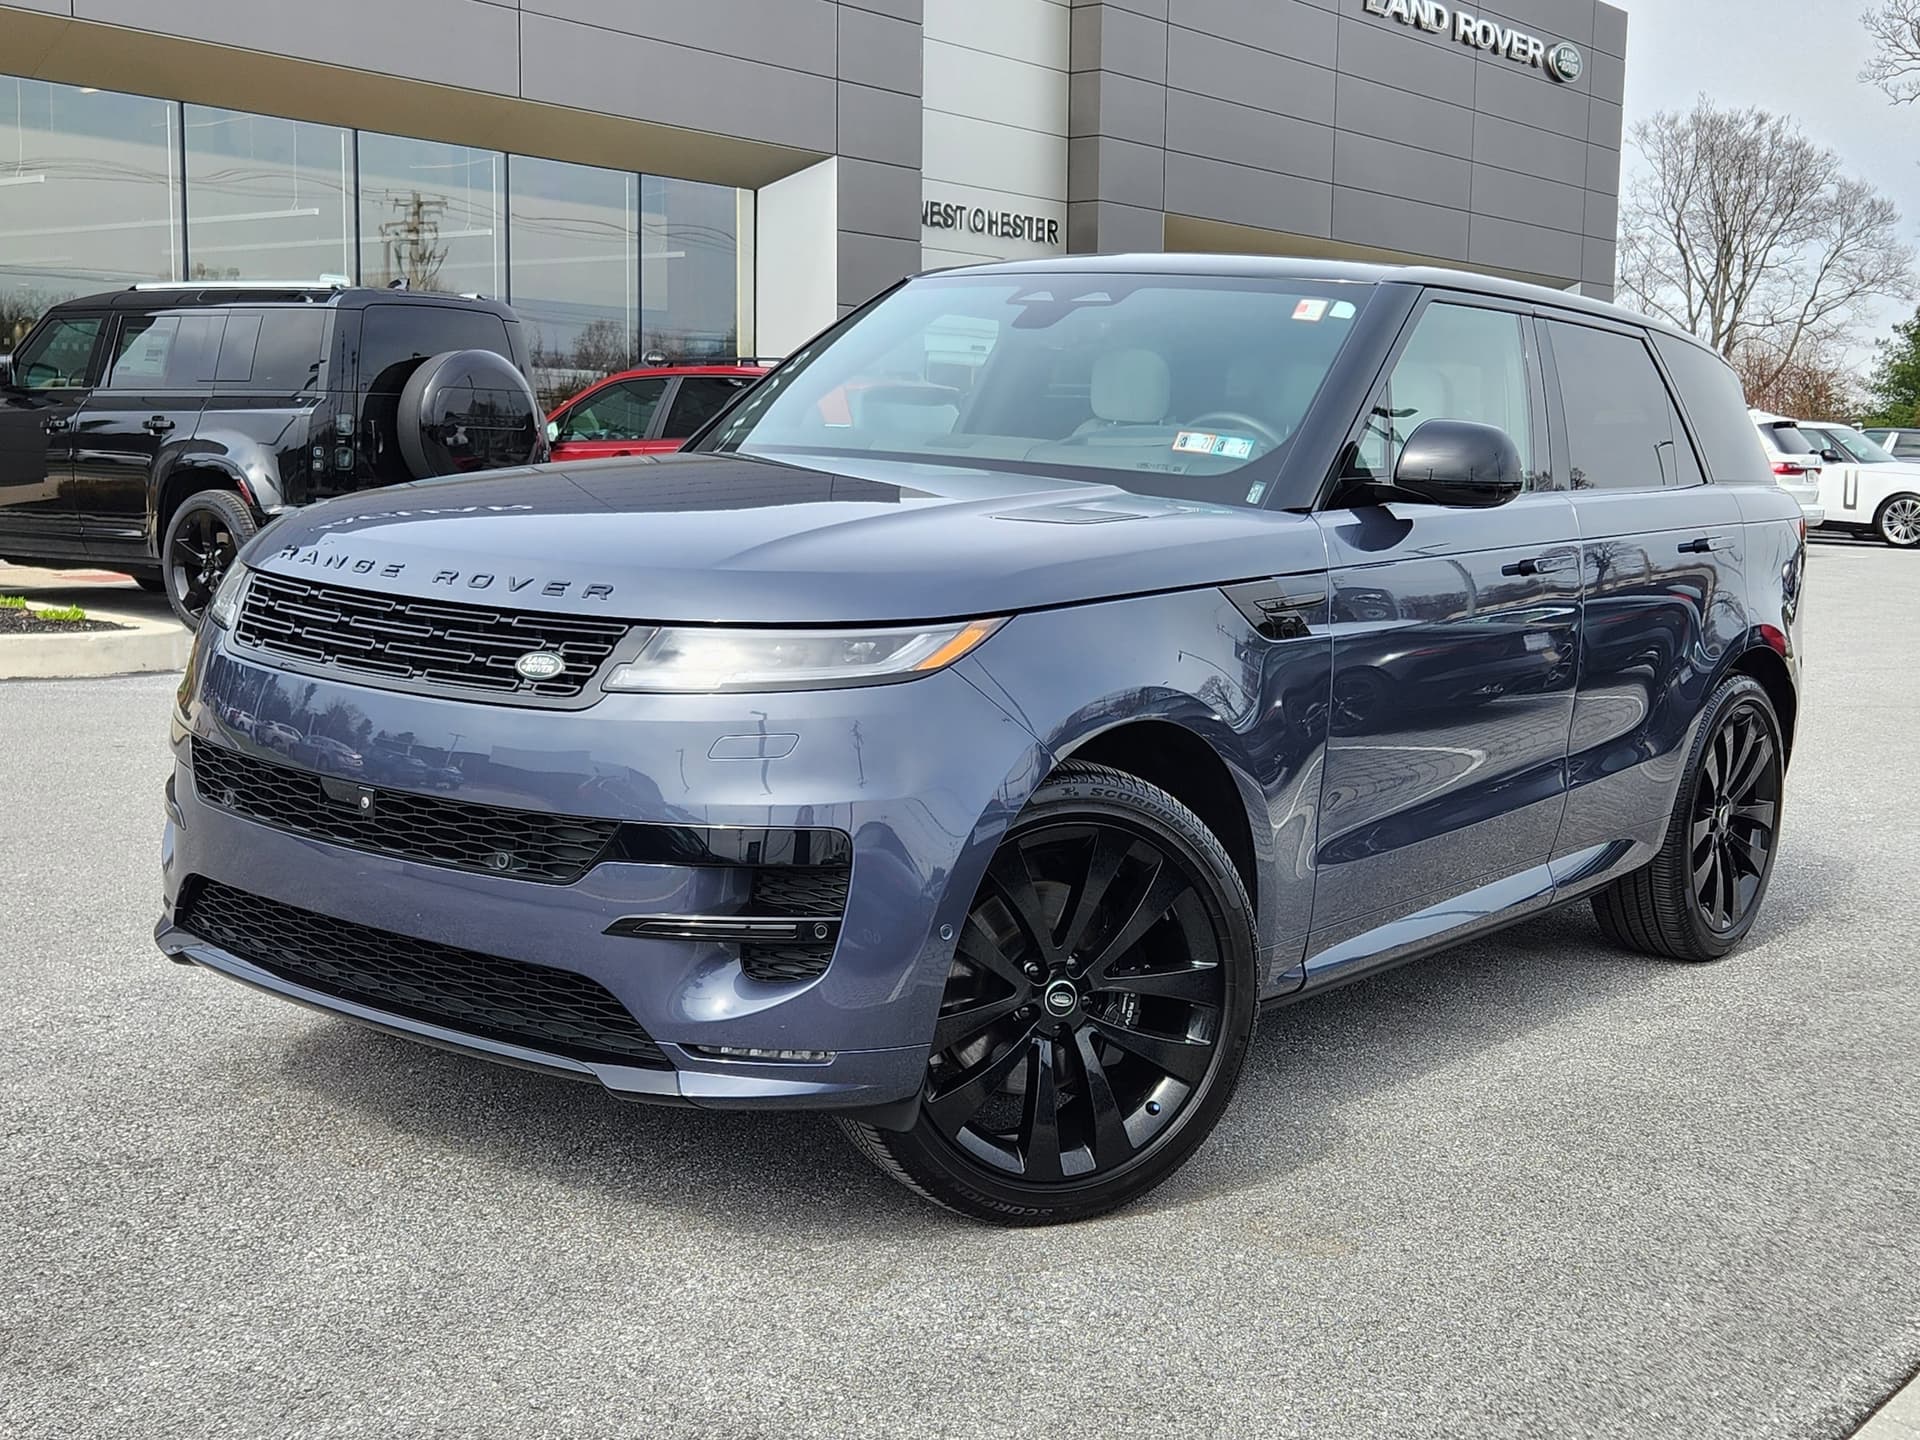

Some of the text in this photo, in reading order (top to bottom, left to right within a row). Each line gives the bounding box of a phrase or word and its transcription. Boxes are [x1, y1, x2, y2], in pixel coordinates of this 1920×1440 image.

[1454, 11, 1546, 68] ROVER
[970, 208, 1058, 244] CHESTER
[279, 545, 615, 601] RANGE ROVER
[1089, 787, 1187, 832] SCORPION
[948, 1183, 1054, 1219] SCORPION
